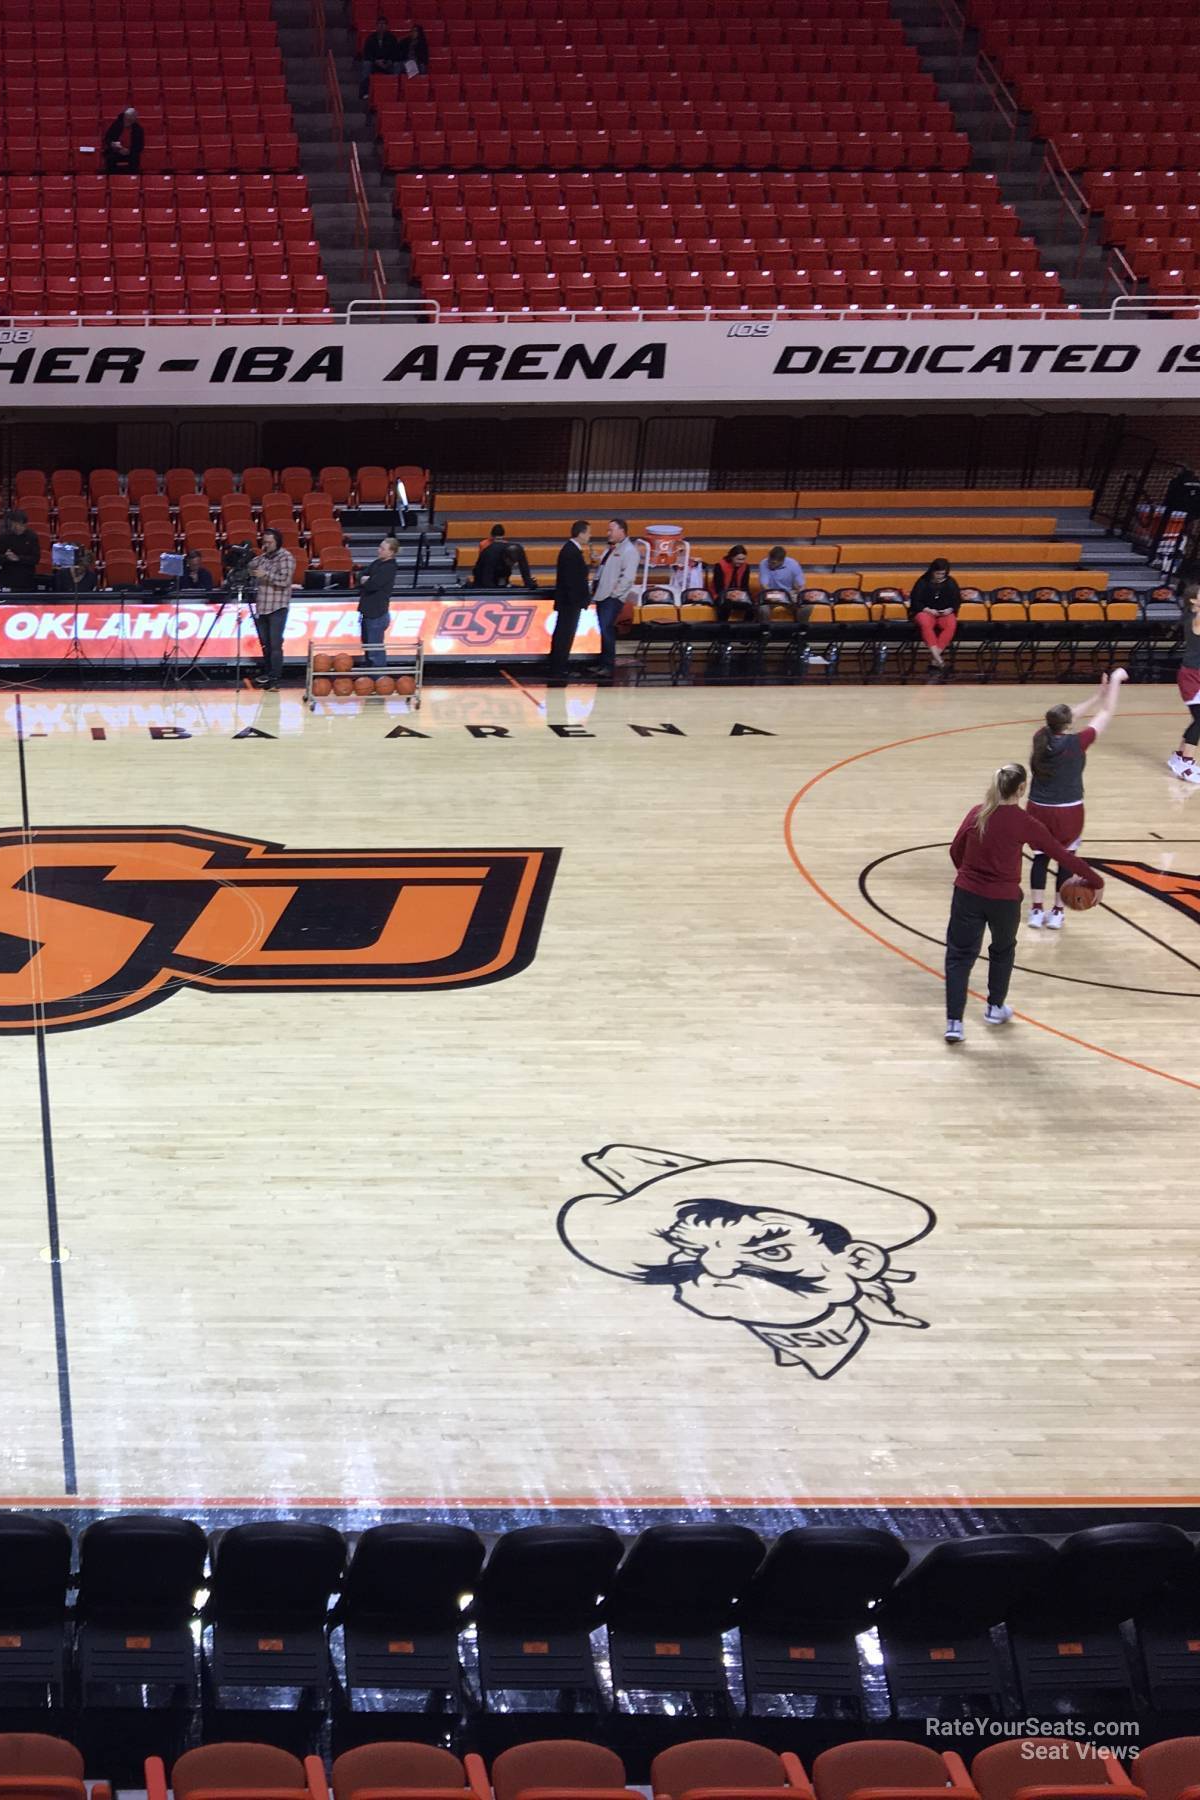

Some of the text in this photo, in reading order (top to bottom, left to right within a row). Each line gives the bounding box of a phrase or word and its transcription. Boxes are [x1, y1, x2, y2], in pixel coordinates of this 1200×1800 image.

[726, 322, 774, 338] 109
[382, 342, 668, 381] ARENA
[772, 343, 1141, 374] DEDICATED
[282, 607, 426, 638] STAE
[434, 600, 537, 647] OSU
[384, 723, 779, 738] ARENA
